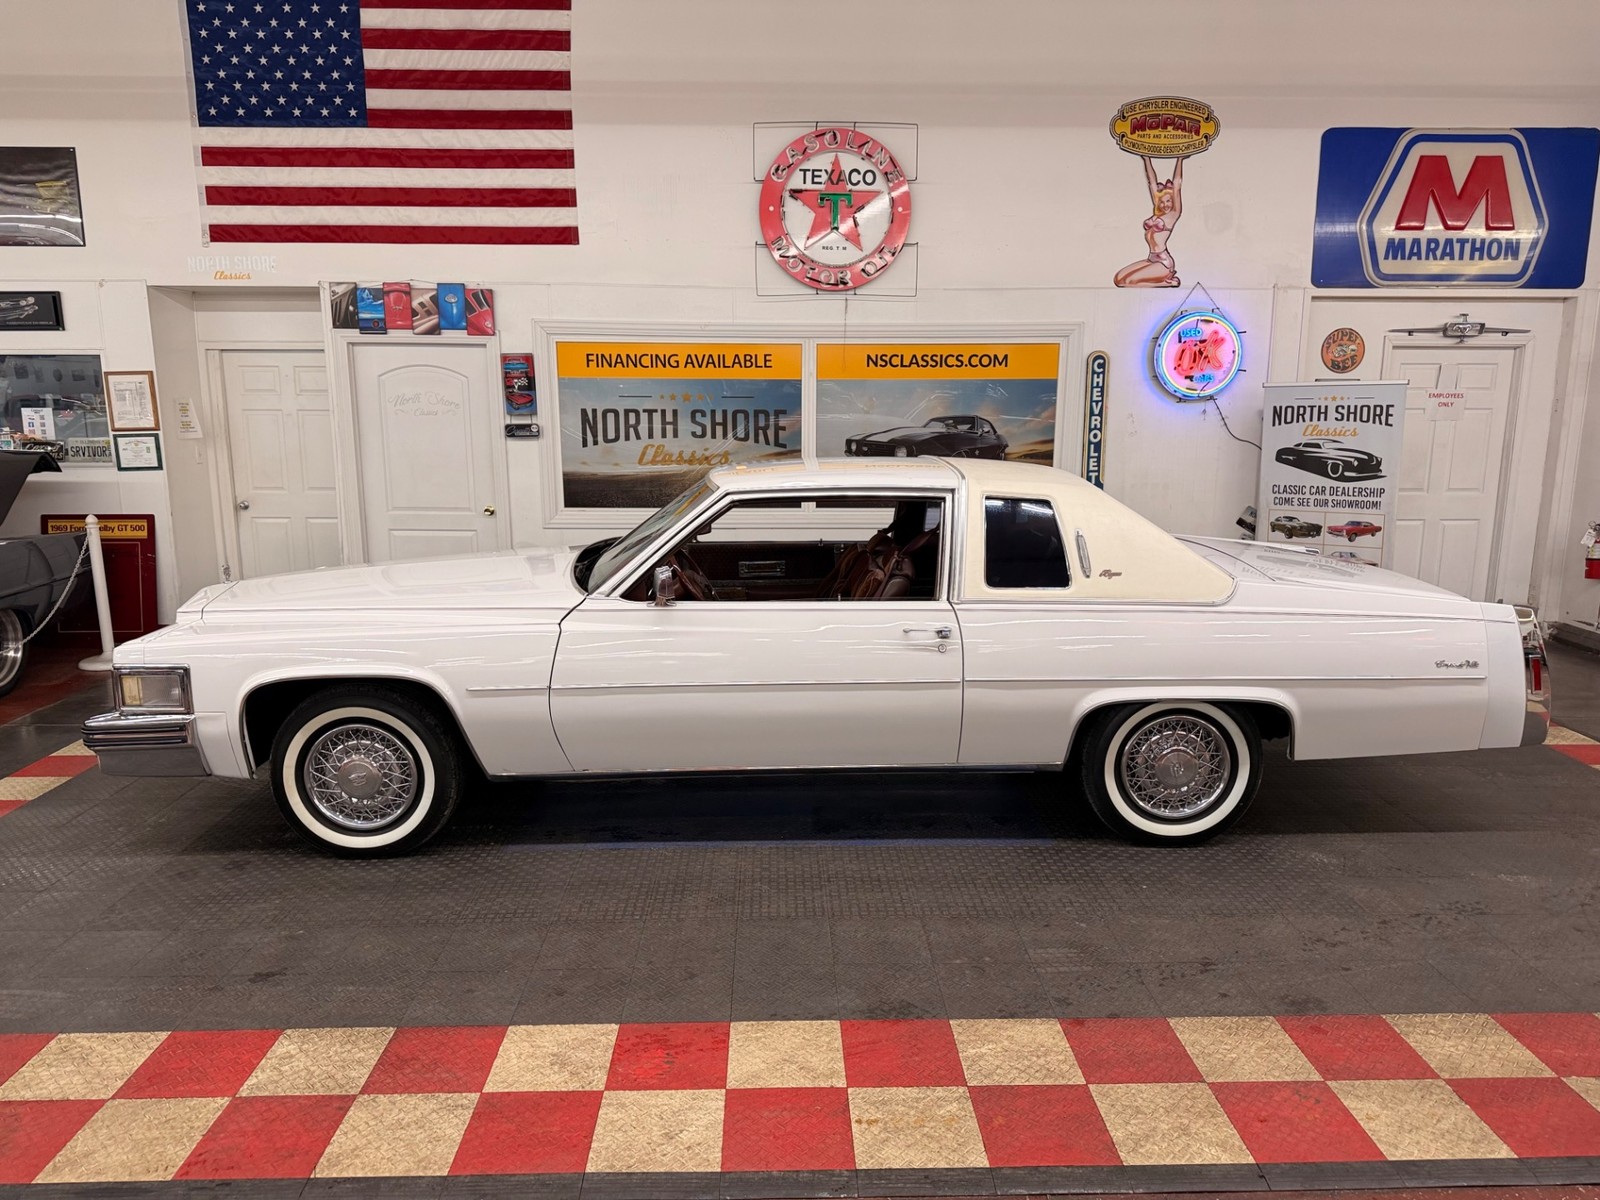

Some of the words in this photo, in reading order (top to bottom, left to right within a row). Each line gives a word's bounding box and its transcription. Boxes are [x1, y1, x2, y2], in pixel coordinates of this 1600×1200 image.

[1125, 104, 1138, 114] USE
[1138, 100, 1169, 111] CHRYSLER
[1170, 101, 1207, 115] ENGINEERED
[770, 130, 904, 187] GASOLINE
[799, 168, 877, 186] TEXACO
[1395, 155, 1515, 231] M
[817, 192, 853, 231] T
[1384, 237, 1521, 261] MARATHON
[770, 235, 853, 288] MOTOR
[861, 244, 900, 278] OIL
[214, 270, 252, 280] Classics
[1180, 328, 1202, 337] USED
[585, 353, 680, 369] FINANCING
[683, 353, 773, 369] AVAILABLE
[866, 353, 1009, 369] NSCLASSICS.COM
[1331, 354, 1358, 370] BEE
[1428, 392, 1464, 400] EMPLOYEES
[1088, 360, 1104, 485] CHEVROLET
[1272, 405, 1329, 427] NORTH
[1334, 404, 1395, 428] SHORE
[580, 408, 679, 449] NORTH
[690, 408, 788, 449] SHORE
[1302, 424, 1359, 437] Classics
[70, 446, 108, 458] SRVIVOR
[637, 444, 731, 466] Classics
[1272, 484, 1307, 496] CLASSIC
[1309, 485, 1327, 497] CAR
[1329, 486, 1386, 499] DEALERSHIP
[1273, 496, 1295, 507] COME
[1297, 497, 1311, 508] SEE
[1313, 498, 1329, 508] OUR
[1331, 498, 1382, 511] SHOWROOM!
[50, 524, 69, 532] 1969
[70, 524, 86, 532] For
